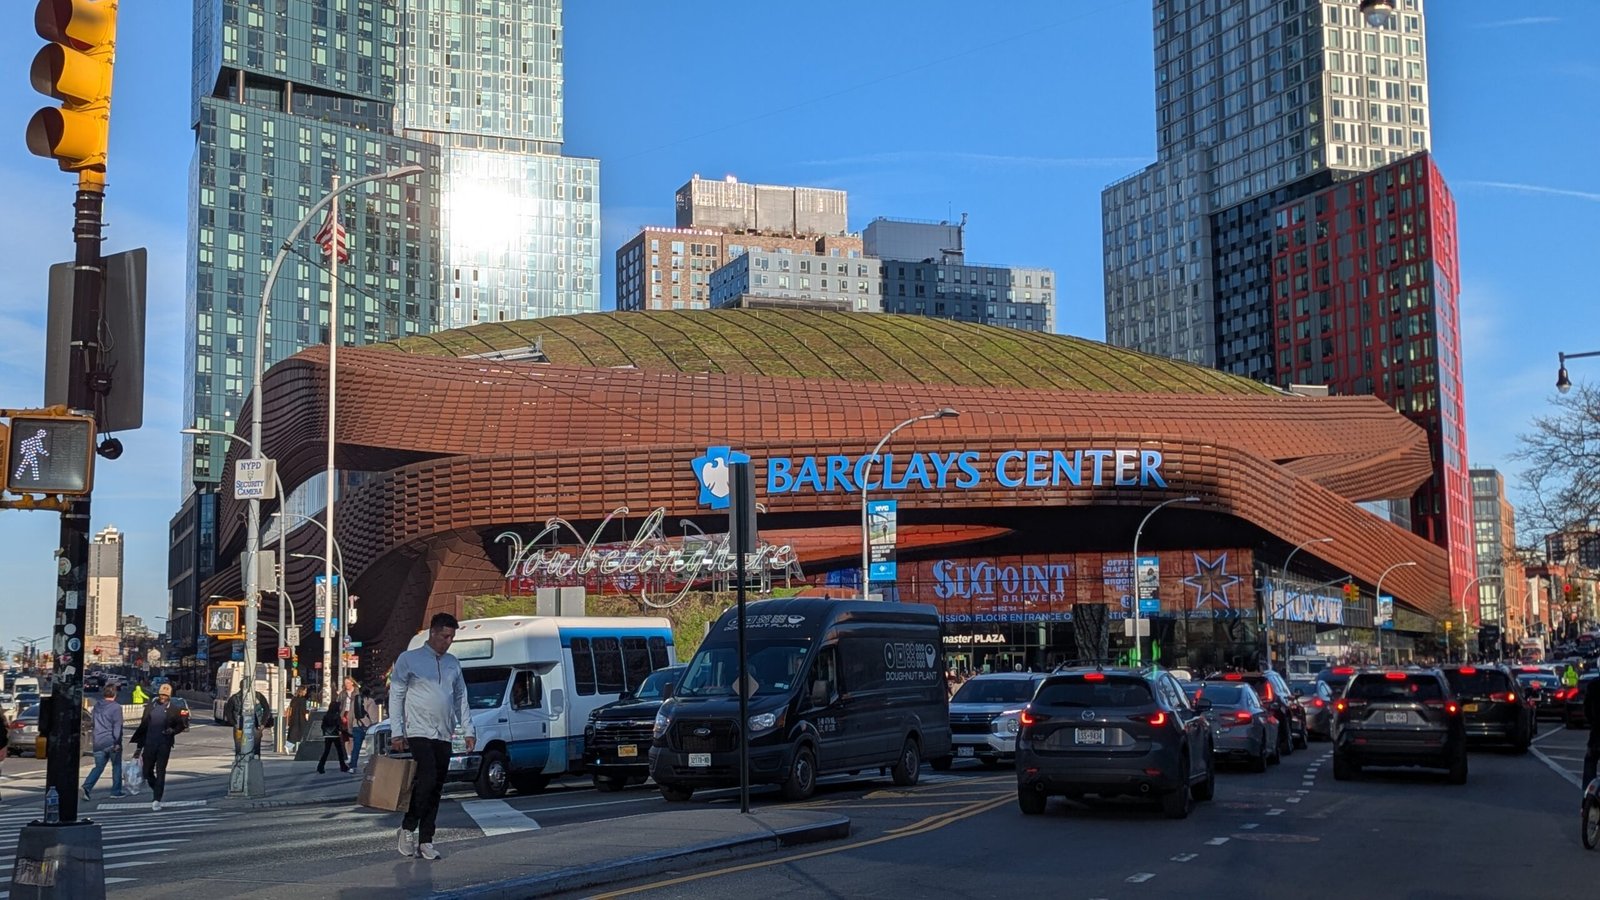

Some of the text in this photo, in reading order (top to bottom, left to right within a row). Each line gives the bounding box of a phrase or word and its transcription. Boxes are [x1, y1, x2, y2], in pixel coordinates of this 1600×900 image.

[241, 462, 261, 470] NYPD
[767, 449, 1168, 493] BARCLAYS CENTER
[236, 480, 264, 488] SECURITY
[1003, 594, 1065, 602] BREWERY
[975, 613, 1007, 621] FLOOR
[1010, 612, 1060, 620] ENTRANCE
[1064, 612, 1072, 620] O
[974, 634, 1006, 643] PLAZA
[886, 671, 937, 680] DOUGHNUT PLANT
